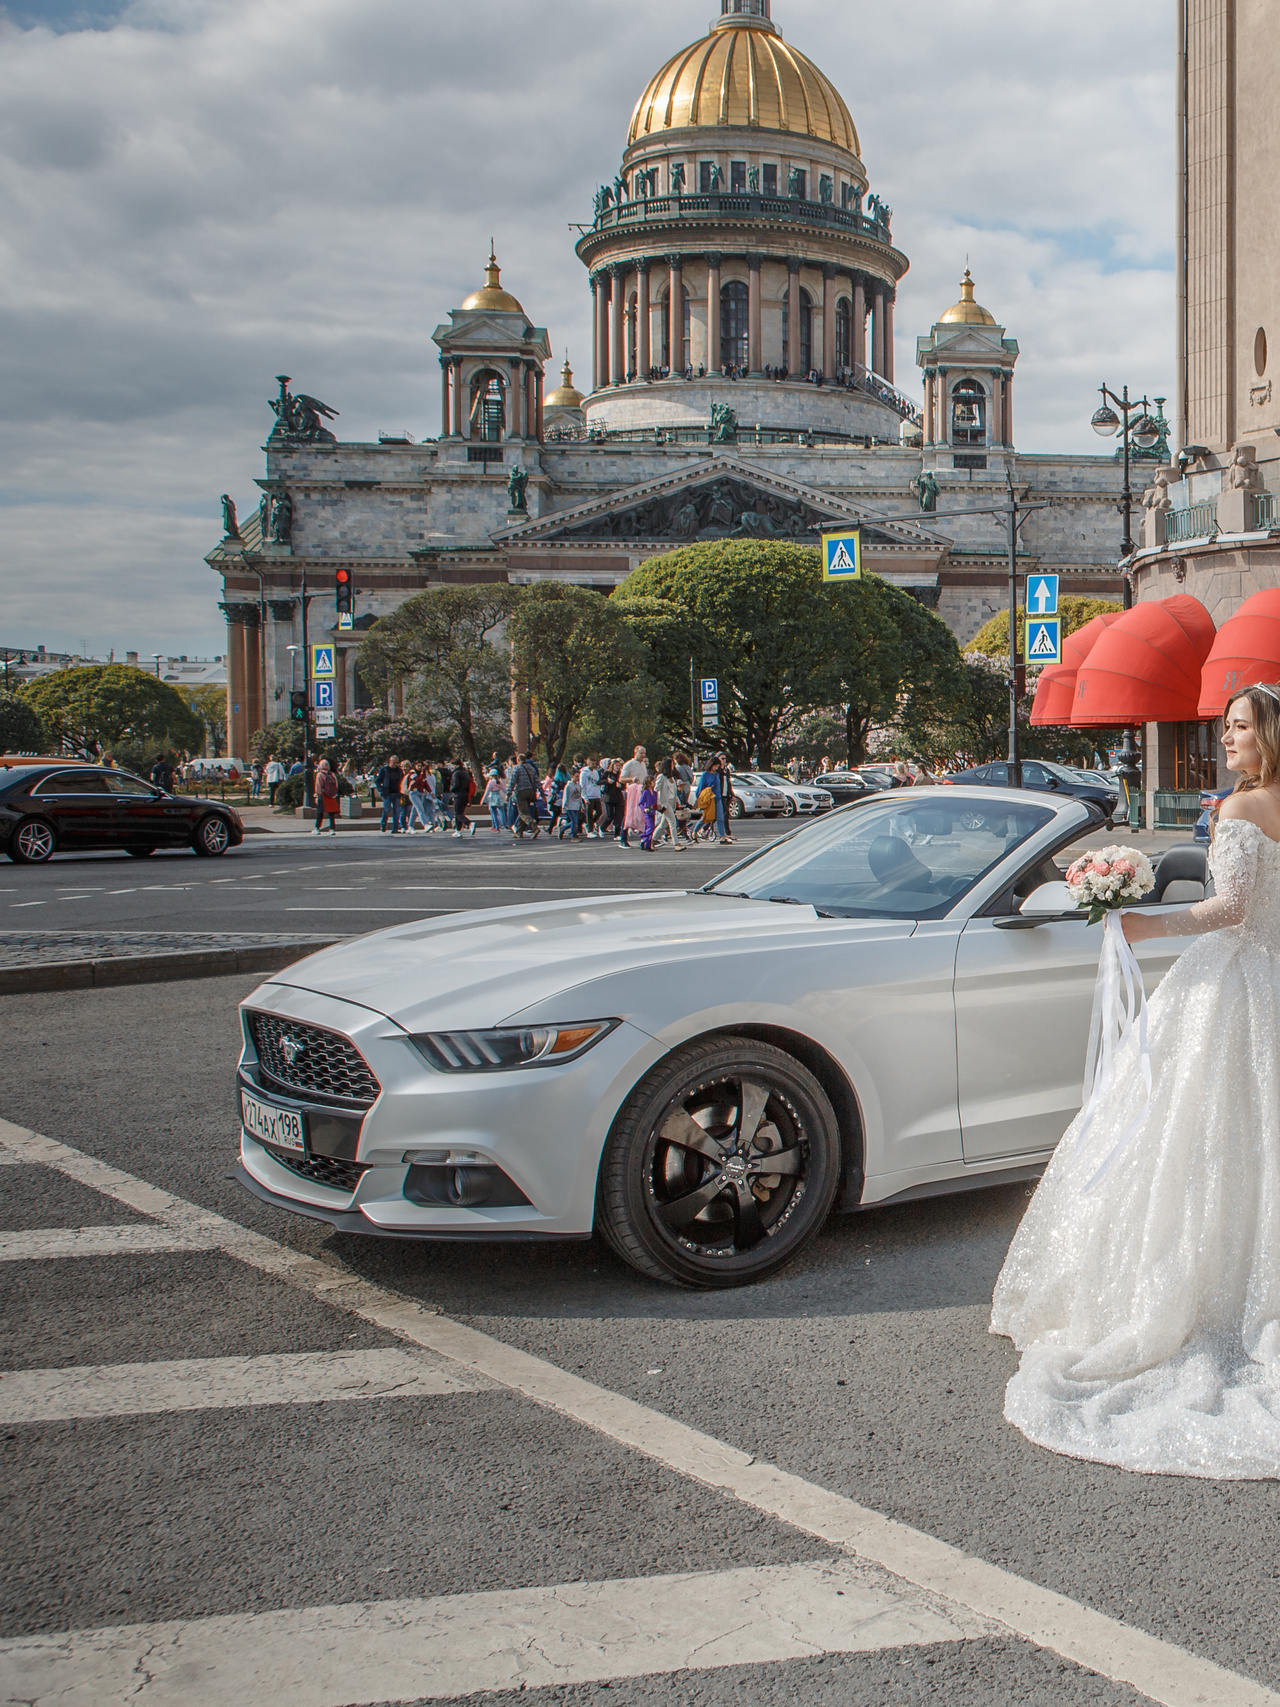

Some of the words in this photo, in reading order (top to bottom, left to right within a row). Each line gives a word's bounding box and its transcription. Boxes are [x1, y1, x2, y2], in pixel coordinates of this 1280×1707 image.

[319, 684, 330, 705] P
[705, 681, 715, 699] P
[278, 1112, 300, 1138] 198
